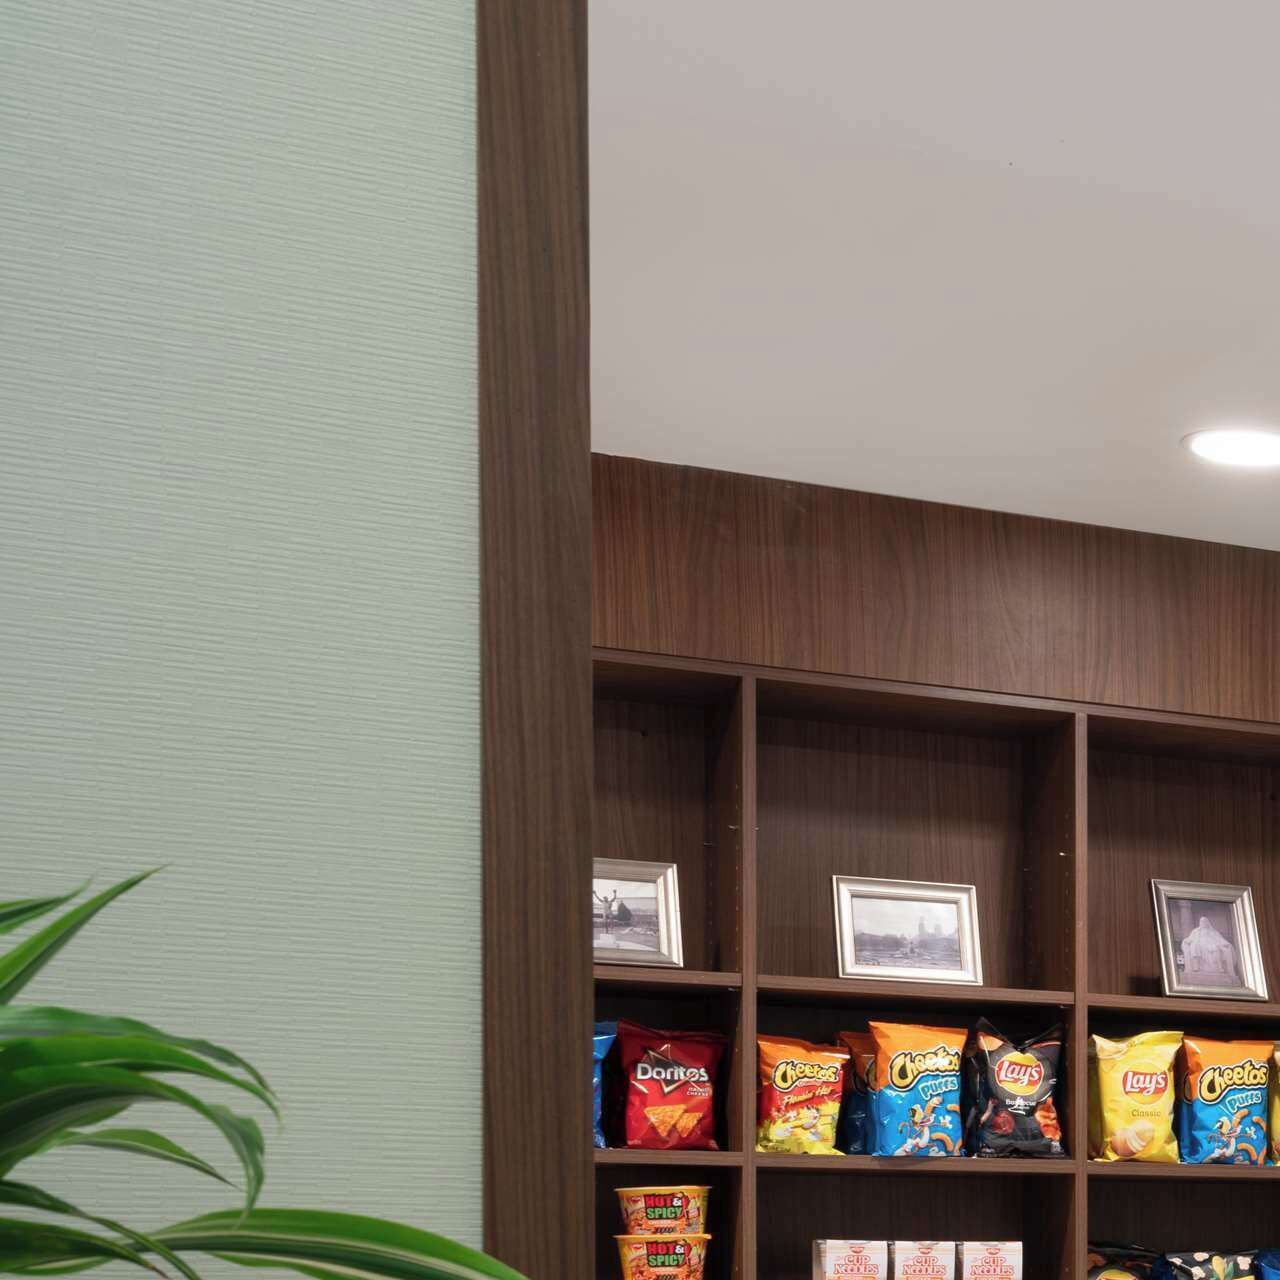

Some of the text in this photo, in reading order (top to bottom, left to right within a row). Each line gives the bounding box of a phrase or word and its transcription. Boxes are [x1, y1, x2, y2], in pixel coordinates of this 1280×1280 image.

[636, 1063, 709, 1082] Doritos
[773, 1060, 839, 1090] Cheetos
[998, 1061, 1040, 1086] Lay's
[1125, 1071, 1166, 1095] Lay's
[1199, 1061, 1268, 1103] Cheetos
[1131, 1109, 1161, 1117] Classic
[646, 1208, 682, 1219] SPICY
[648, 1255, 684, 1266] SPICY
[844, 1255, 870, 1265] CUP
[913, 1256, 938, 1266] CUP
[980, 1256, 1006, 1266] CUP
